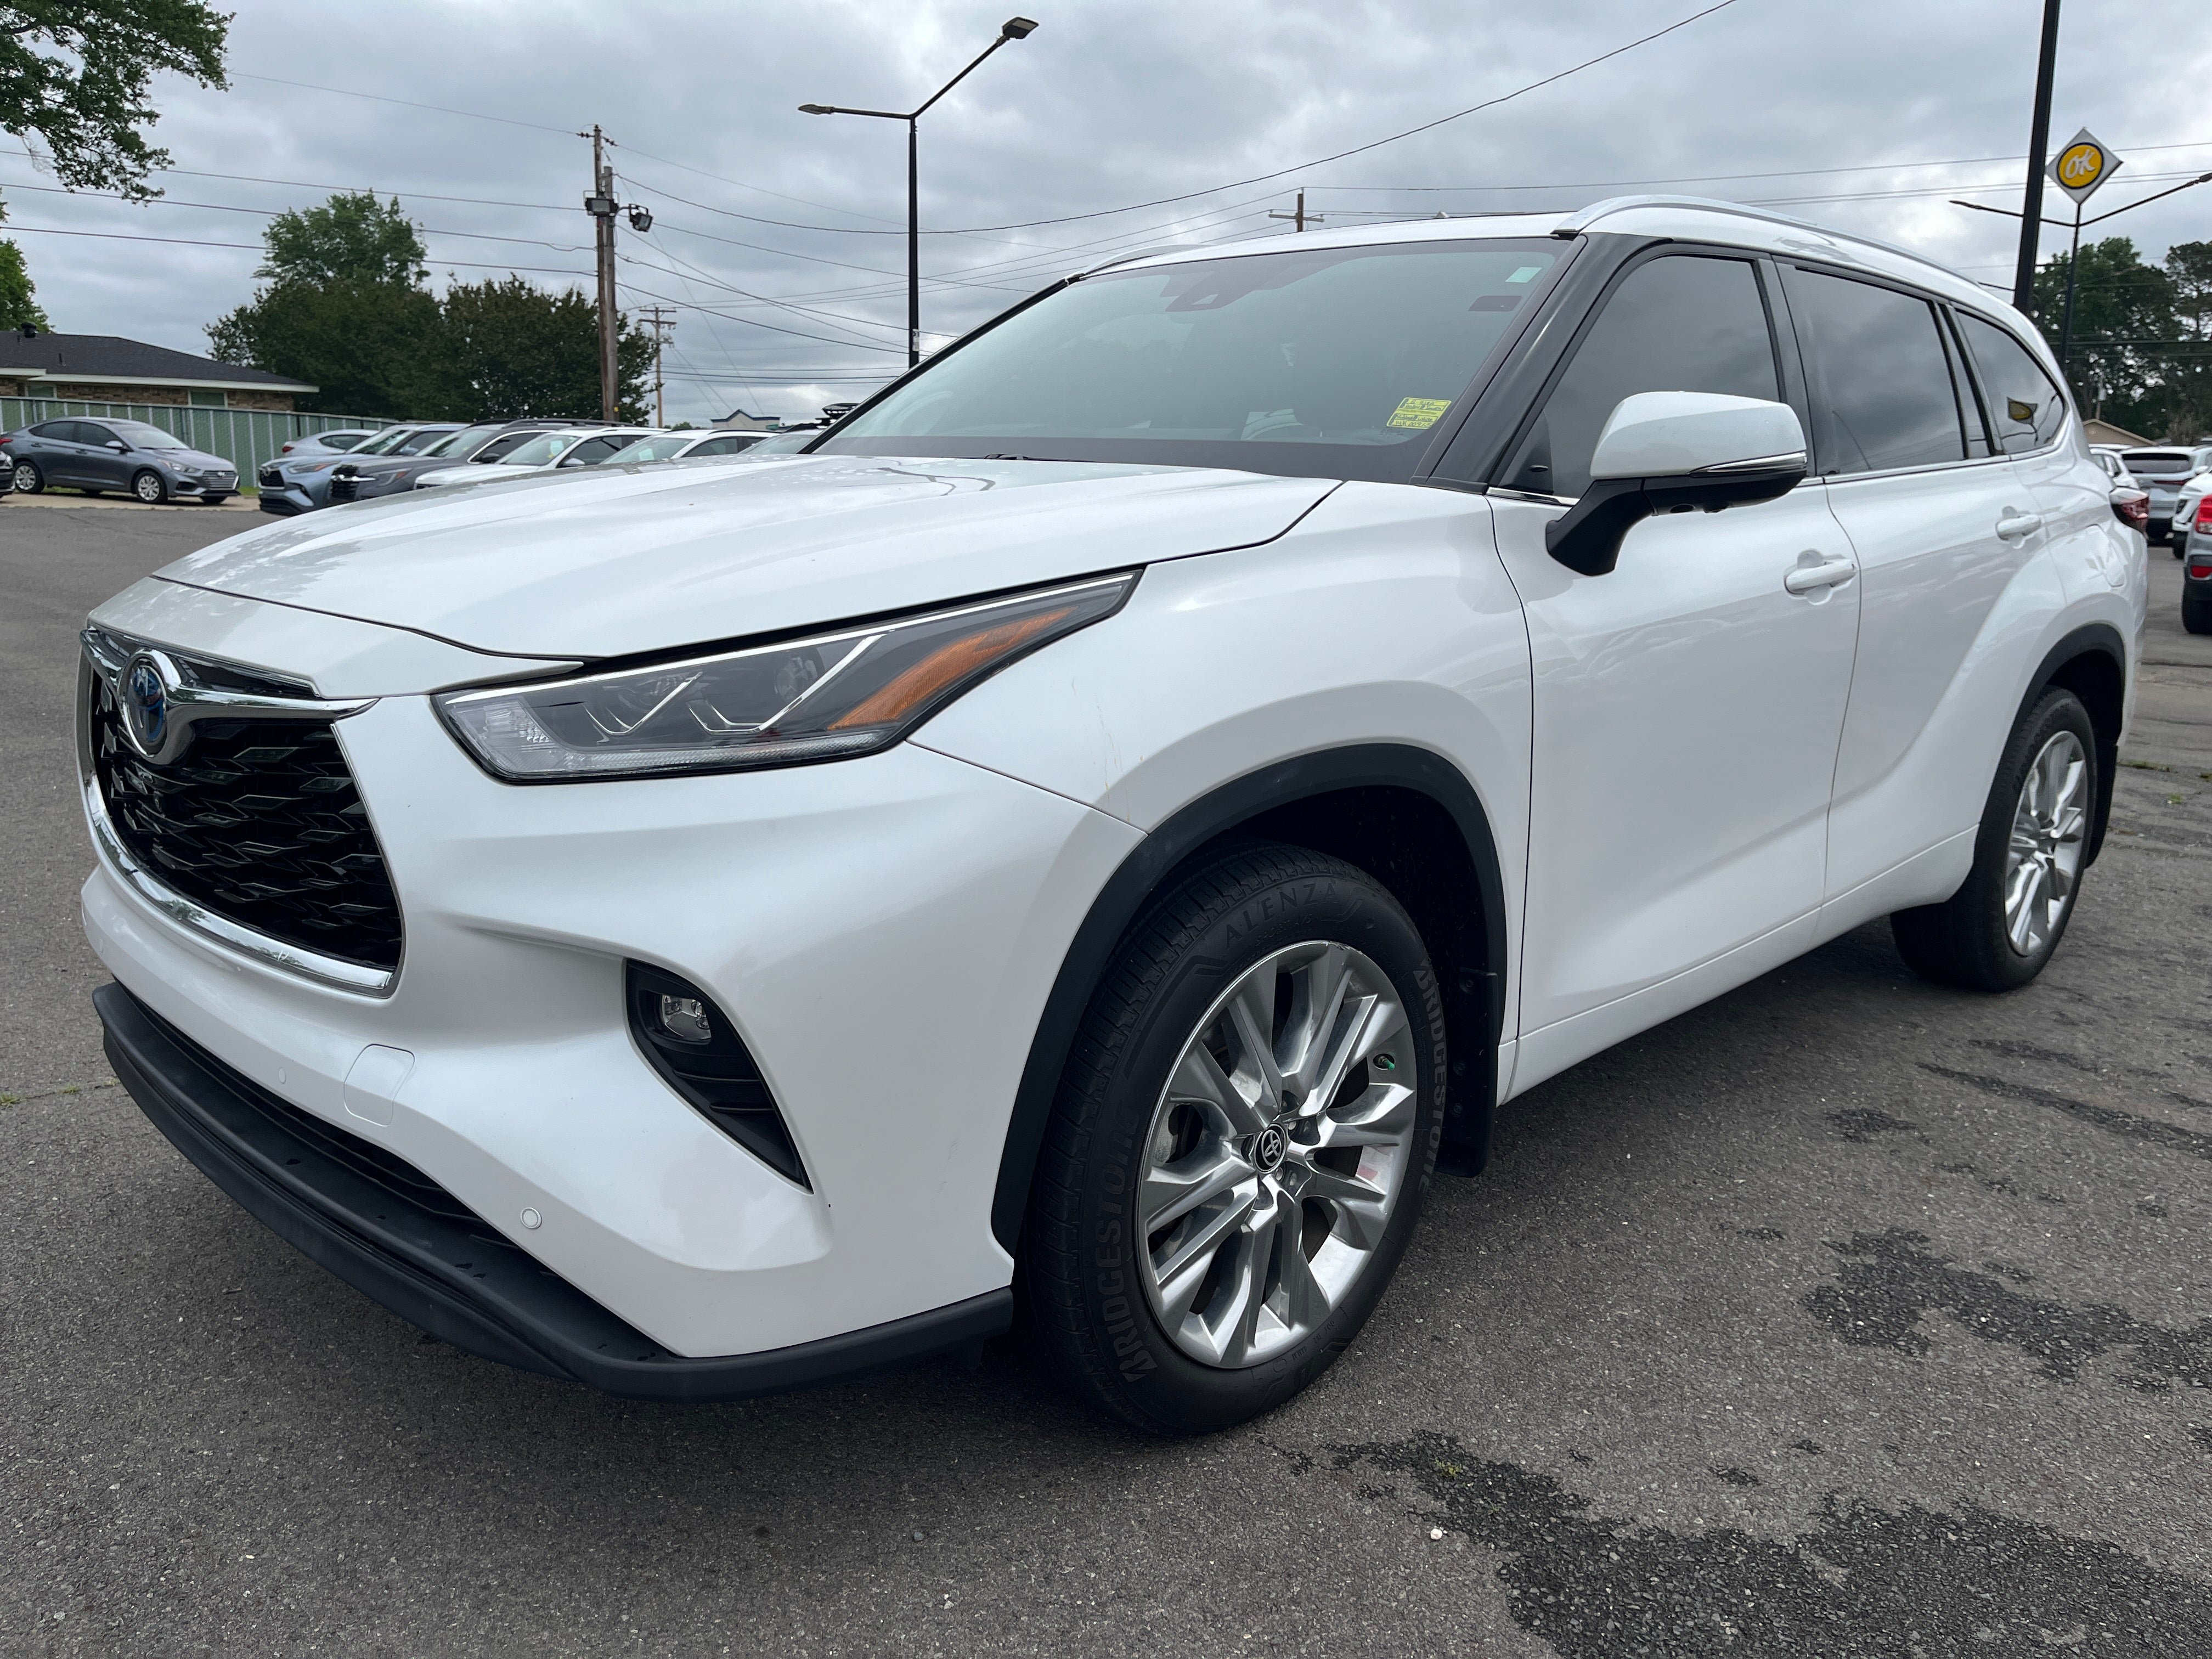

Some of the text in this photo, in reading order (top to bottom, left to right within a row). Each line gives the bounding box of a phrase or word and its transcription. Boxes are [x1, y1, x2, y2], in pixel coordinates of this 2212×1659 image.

[2065, 149, 2095, 179] OK
[1226, 881, 1342, 950] ALENZA
[1096, 1102, 1158, 1383] BRIDGESTONE
